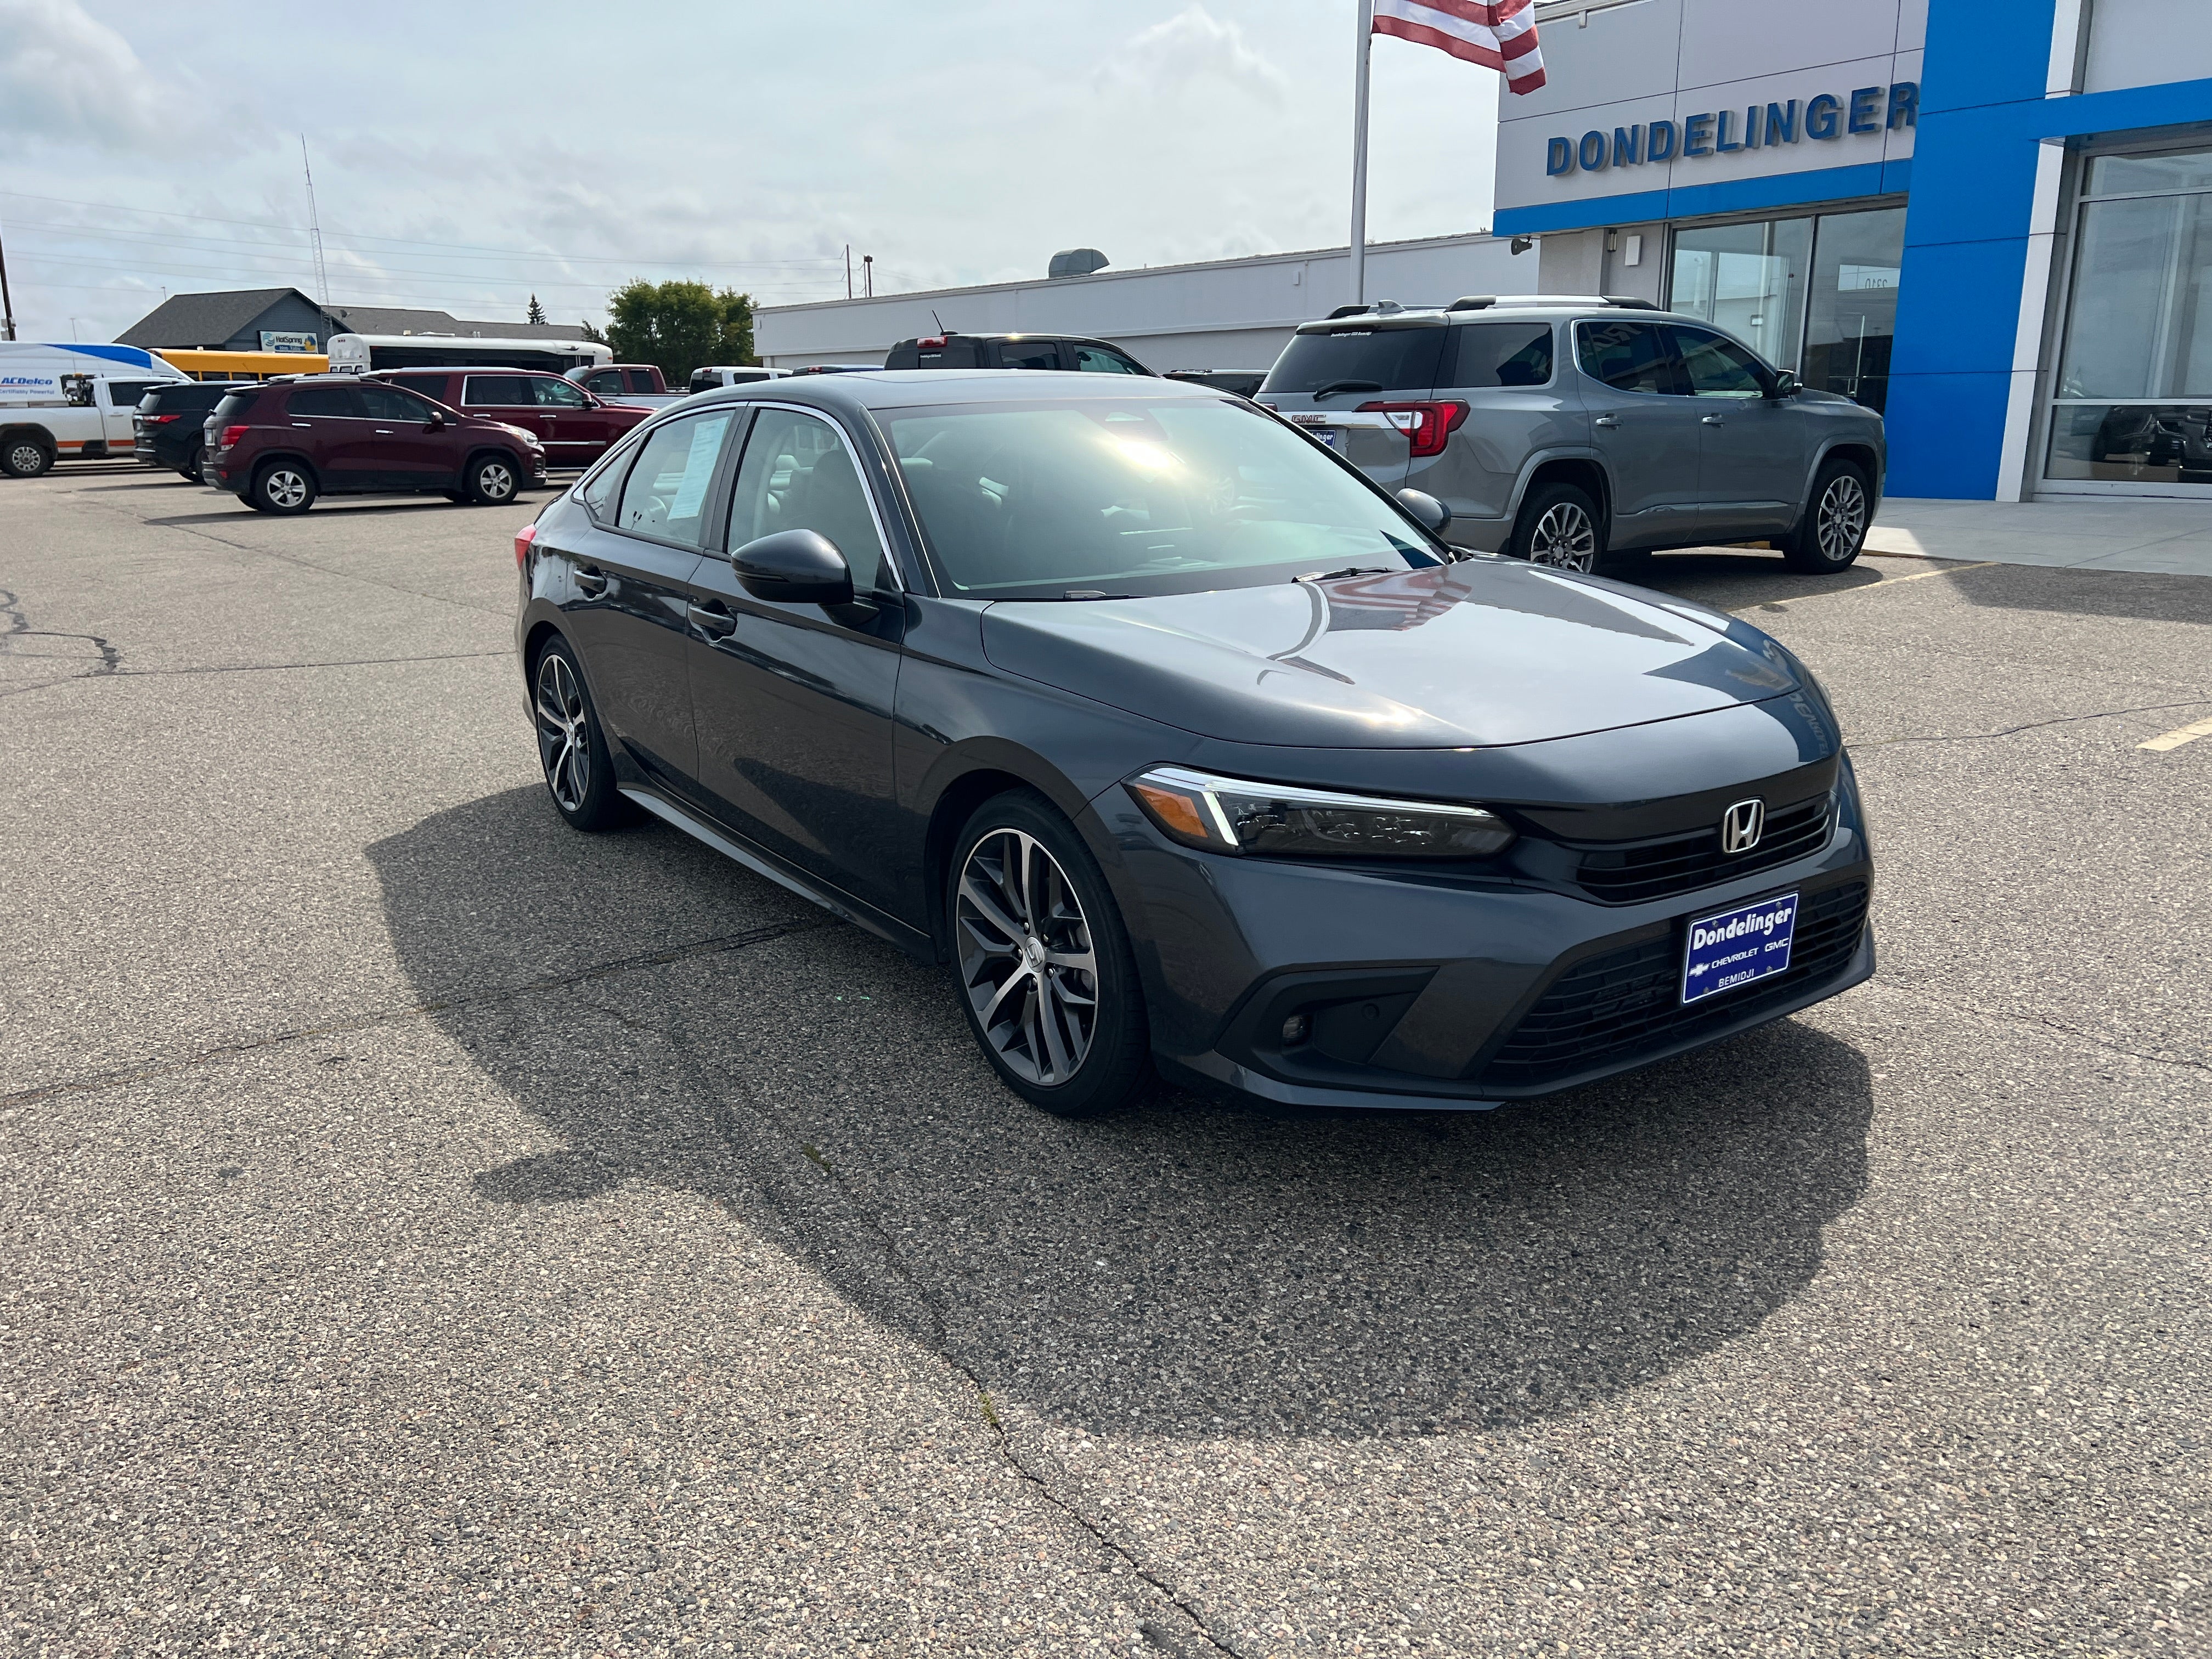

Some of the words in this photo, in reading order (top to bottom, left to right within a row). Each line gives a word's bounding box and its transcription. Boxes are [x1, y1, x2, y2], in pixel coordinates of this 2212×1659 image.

[1547, 82, 1919, 176] DONDELINGER
[1, 377, 53, 385] ACDelco
[1291, 415, 1327, 424] GMC
[1693, 907, 1792, 950] Dondelinger
[1711, 947, 1759, 969] CHEVROLET
[1764, 938, 1789, 952] GMC
[1718, 968, 1754, 988] BEMIDJI
